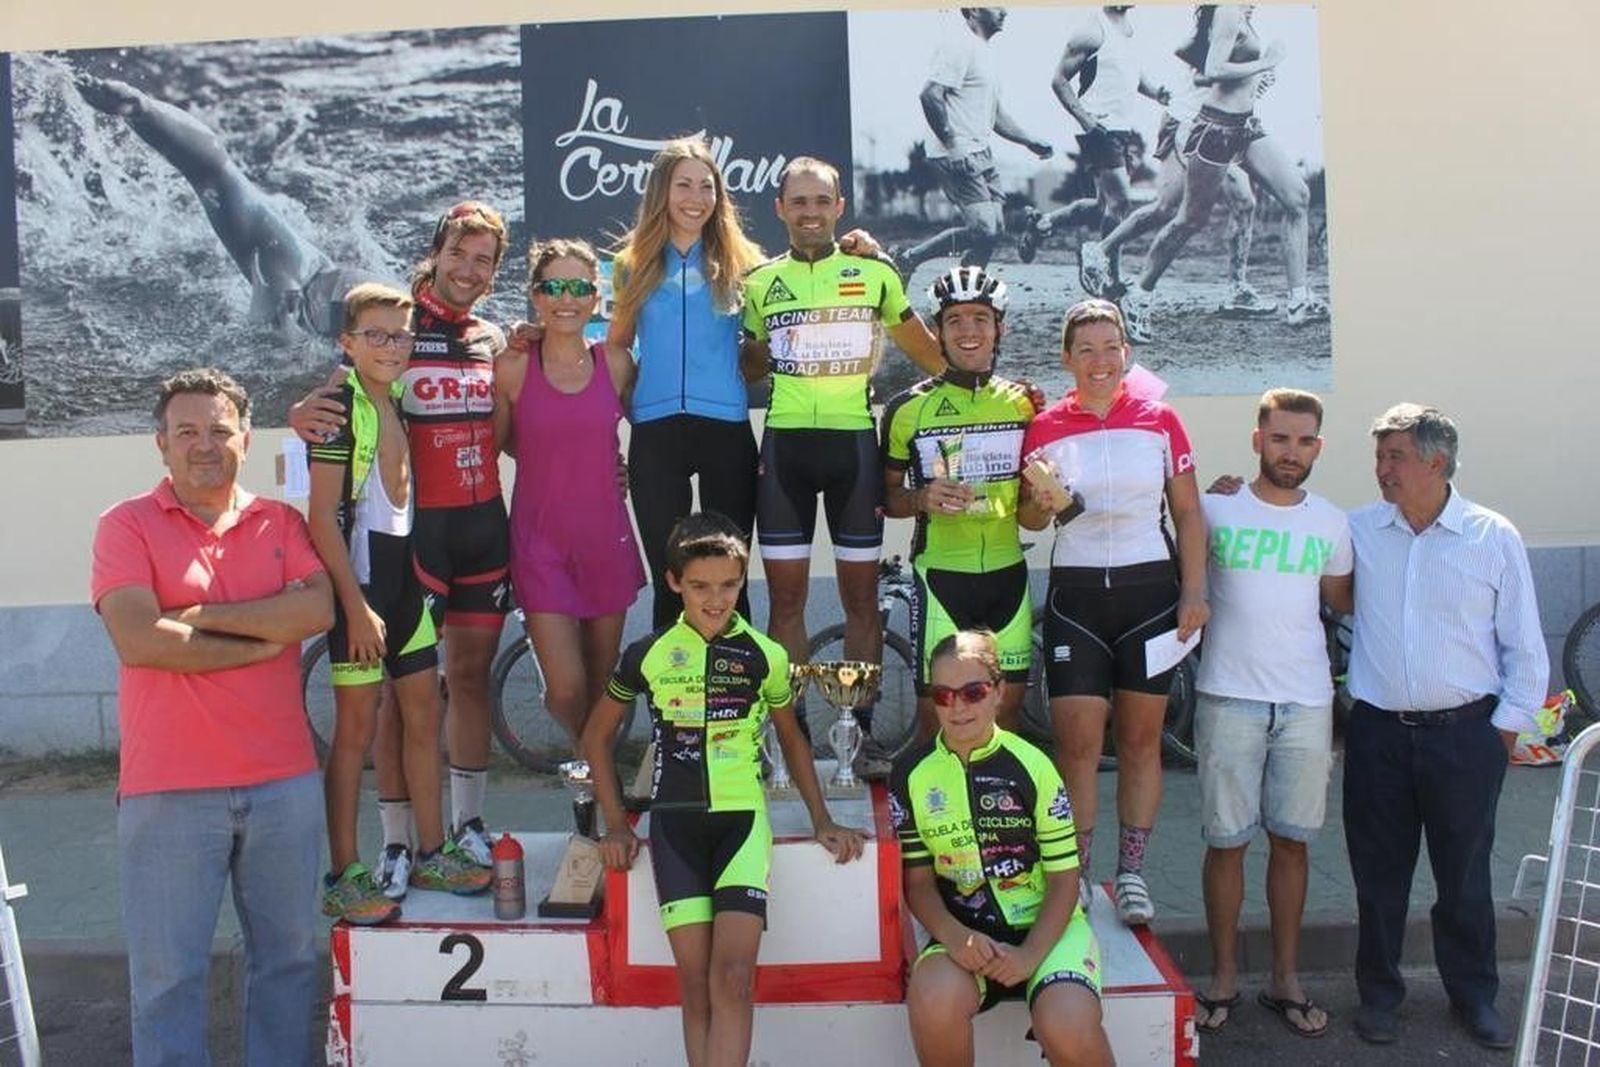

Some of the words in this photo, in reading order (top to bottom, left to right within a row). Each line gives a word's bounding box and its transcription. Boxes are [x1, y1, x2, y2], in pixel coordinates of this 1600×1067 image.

[555, 78, 642, 148] La
[828, 308, 874, 322] TEAM
[777, 361, 820, 375] ROAD
[829, 361, 861, 374] BTT
[1212, 526, 1333, 575] REPLAY
[978, 816, 1033, 829] CICLISMO
[438, 933, 487, 1001] 2
